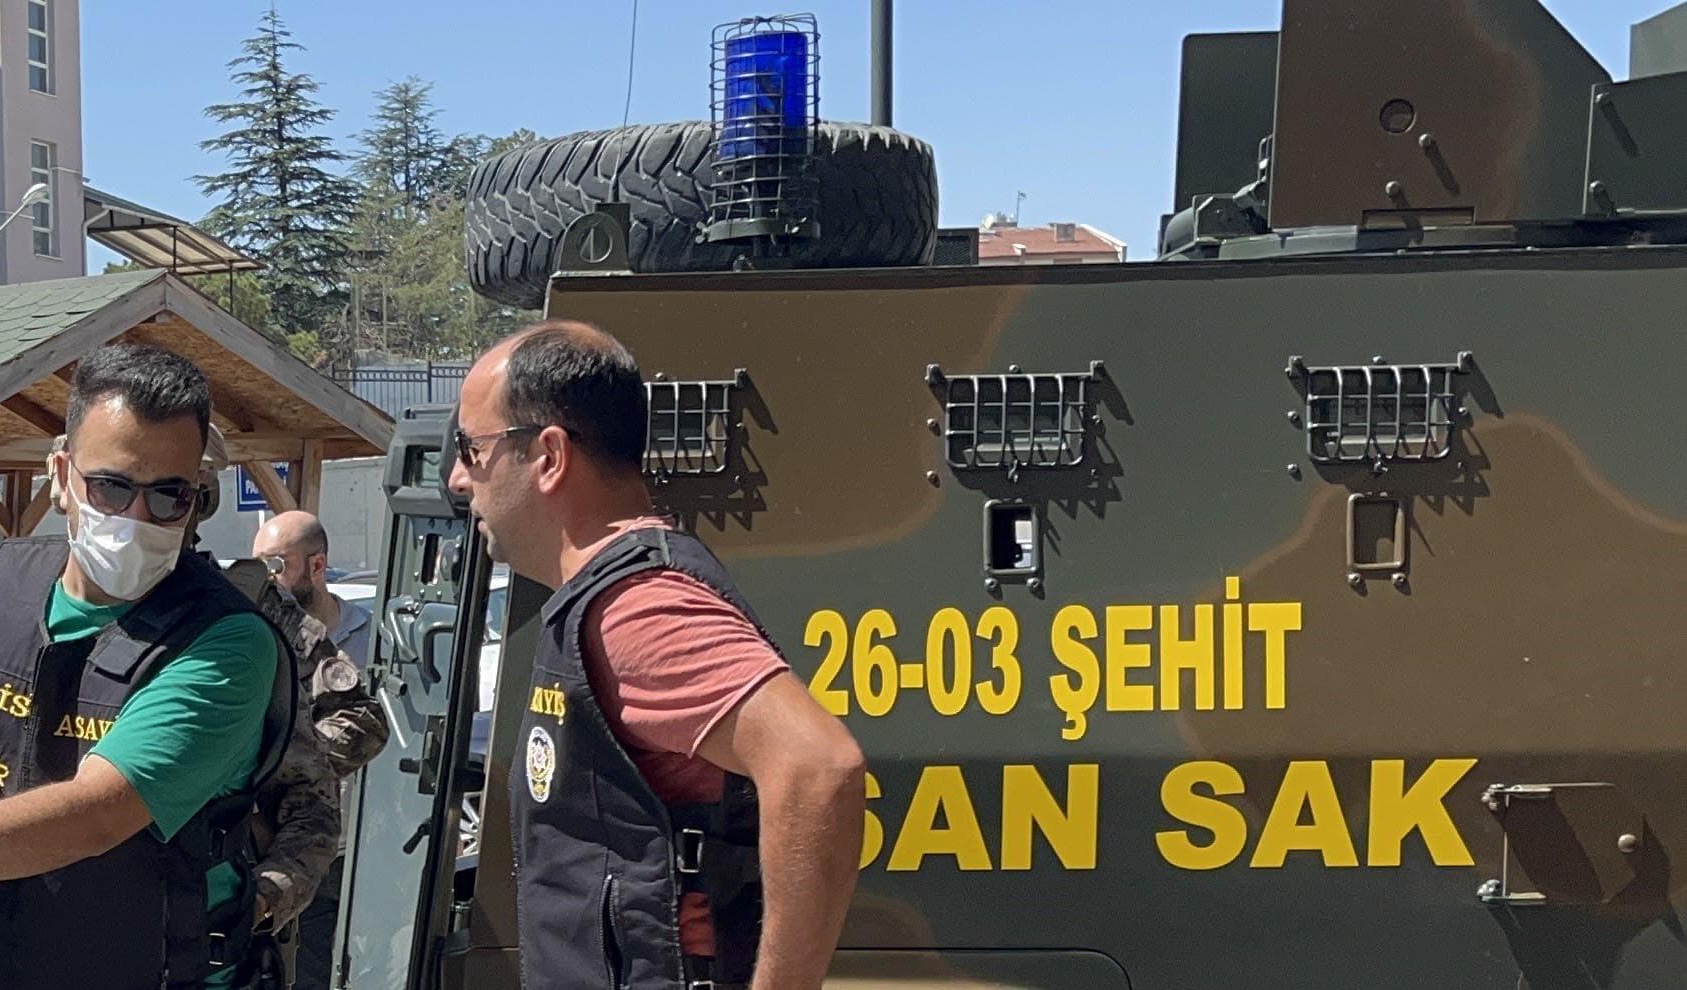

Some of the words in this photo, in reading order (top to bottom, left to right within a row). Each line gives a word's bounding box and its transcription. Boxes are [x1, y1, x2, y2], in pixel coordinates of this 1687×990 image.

[803, 608, 1022, 716] 26-03
[1049, 575, 1302, 741] ŞEHİT
[1155, 757, 1479, 870] SAK
